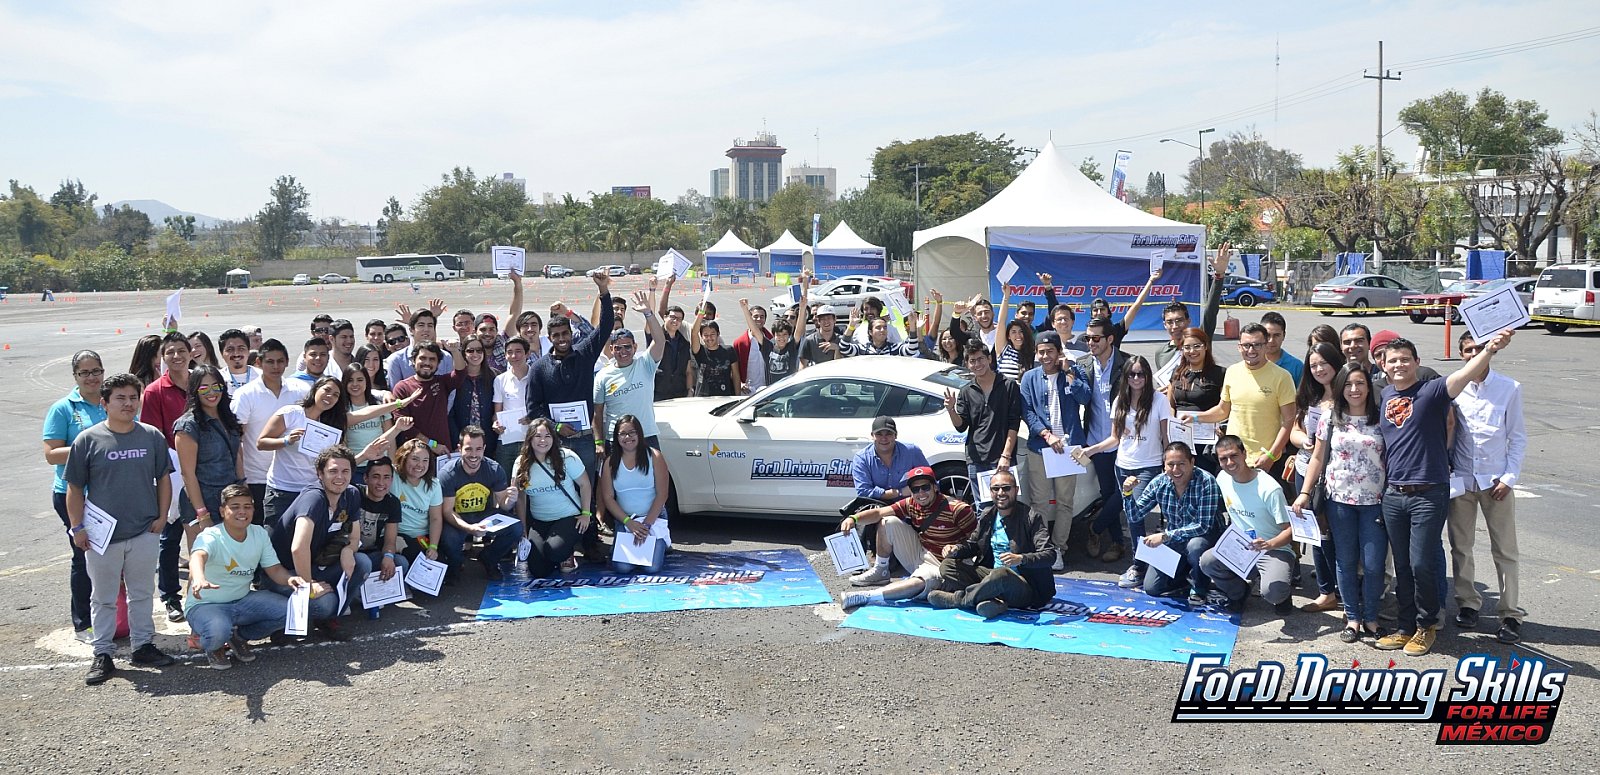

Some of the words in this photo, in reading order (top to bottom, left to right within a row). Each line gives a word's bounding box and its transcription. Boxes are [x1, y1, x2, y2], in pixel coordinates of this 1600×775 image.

[1151, 234, 1178, 247] Driving
[1179, 234, 1198, 245] Skills
[1091, 285, 1103, 297] Y
[613, 381, 644, 398] enactus
[716, 450, 747, 459] enactus
[783, 459, 829, 480] Driving
[460, 497, 484, 509] 5TH
[699, 569, 765, 582] Skills
[1102, 605, 1183, 622] Skills
